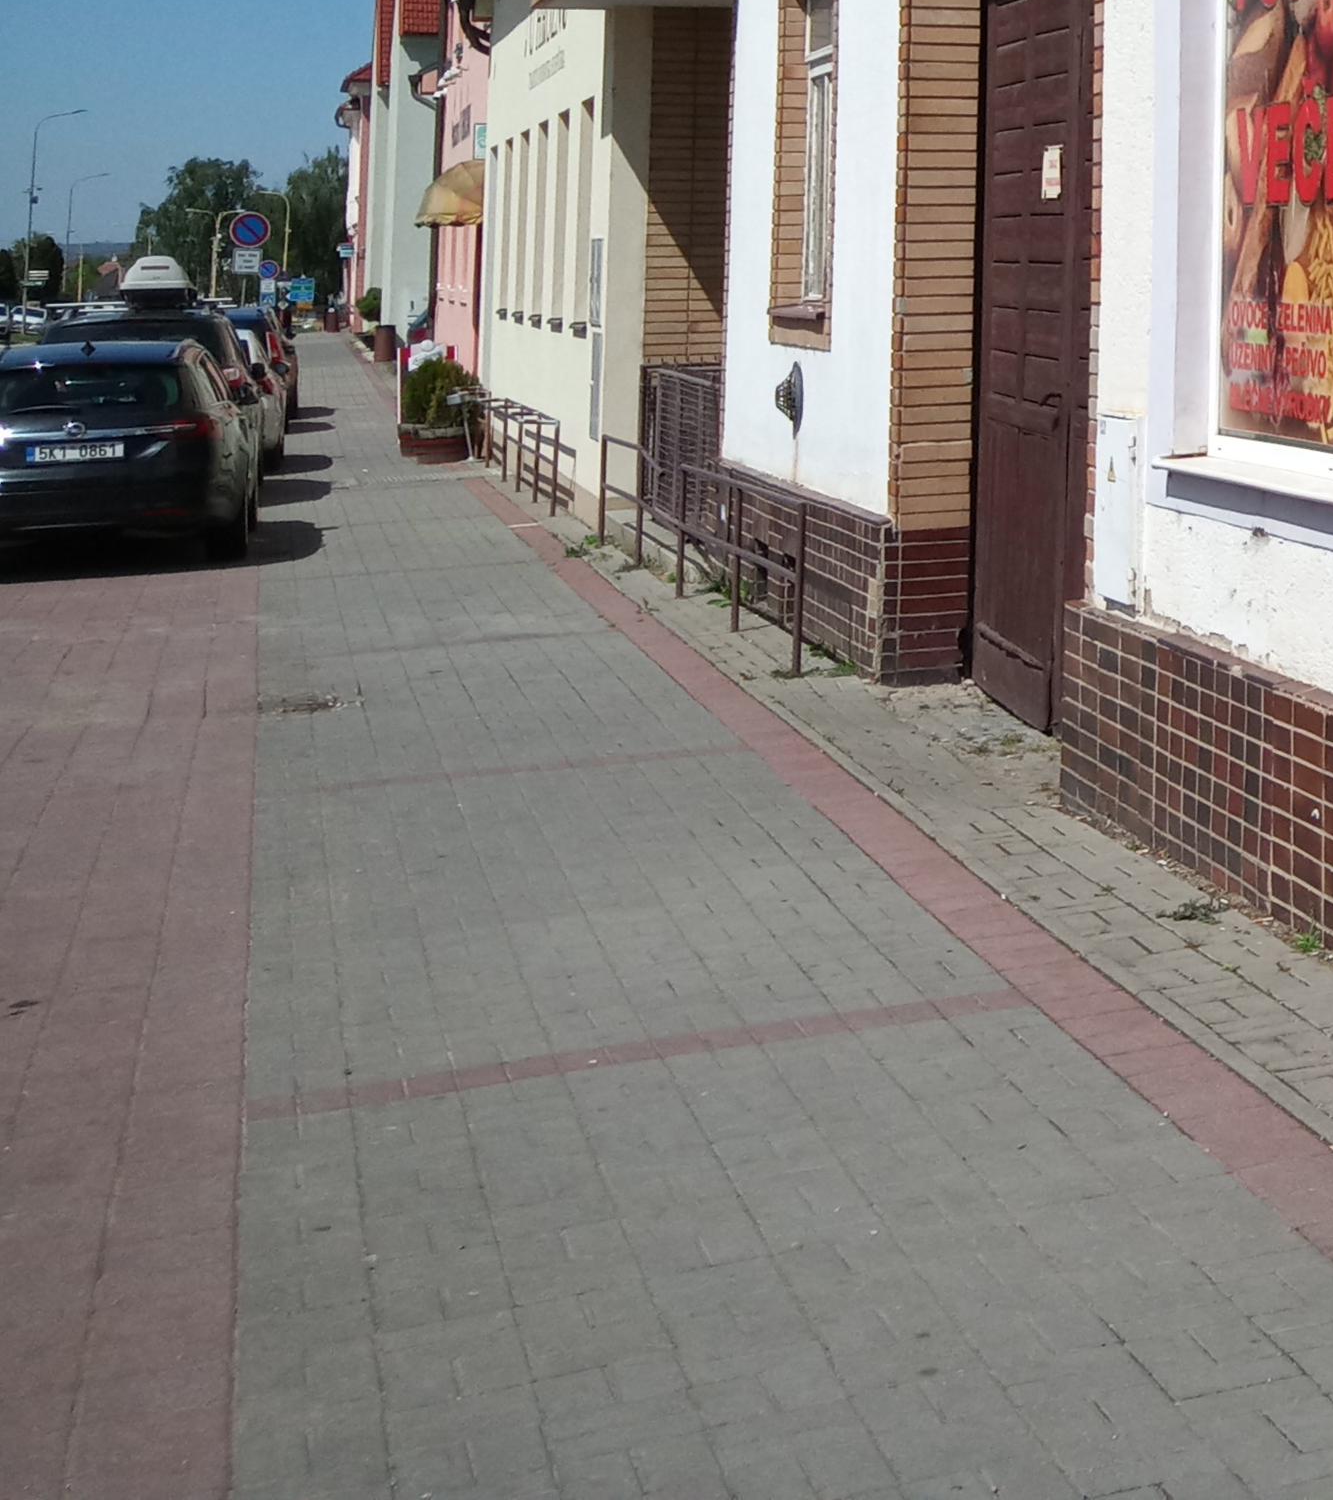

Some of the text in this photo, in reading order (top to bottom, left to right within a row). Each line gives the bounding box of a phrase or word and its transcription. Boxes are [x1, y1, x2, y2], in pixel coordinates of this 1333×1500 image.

[1232, 301, 1333, 334] OVOCE ZELENINA
[1284, 342, 1327, 379] PEČIVO
